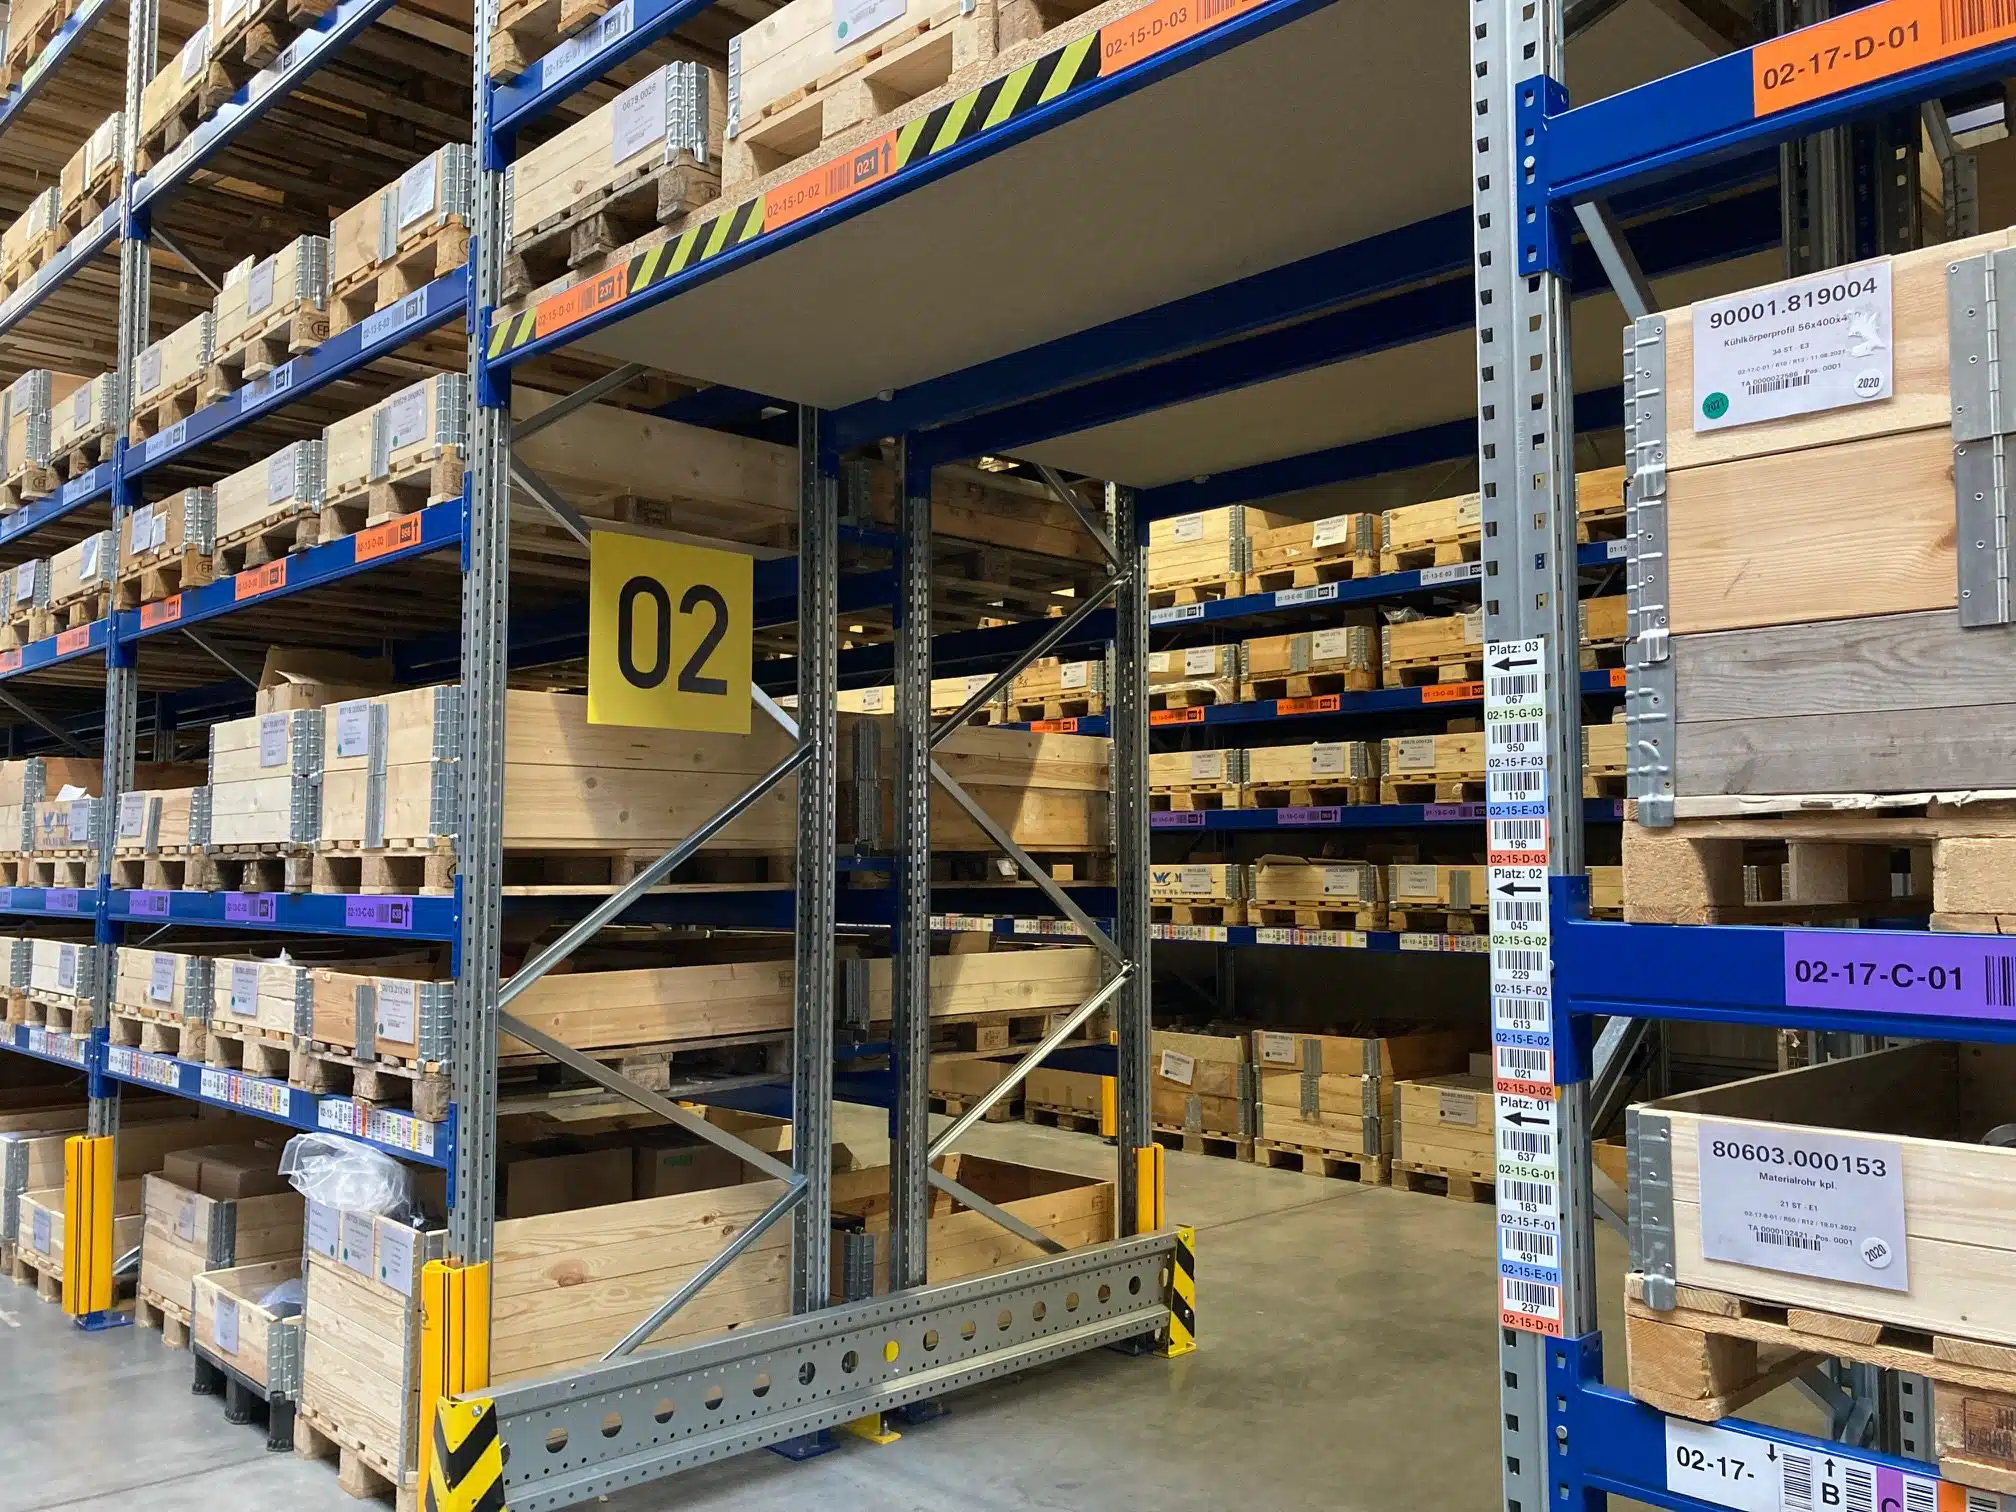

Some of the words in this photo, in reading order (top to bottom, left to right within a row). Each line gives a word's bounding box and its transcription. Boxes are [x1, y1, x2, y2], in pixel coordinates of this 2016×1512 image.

[1105, 8, 1188, 58] 02-15-D-03
[1763, 20, 1919, 90] 02-17-D-01
[767, 183, 820, 218] 02-15-D-02
[856, 156, 875, 176] 021
[537, 301, 574, 327] 02-15-D-01
[599, 281, 613, 298] 237
[1710, 277, 1878, 329] 90001.819004
[1723, 325, 1795, 348] Kühlkörperprofil
[1772, 347, 1782, 356] 34
[1784, 345, 1793, 354] ST
[1800, 342, 1809, 351] E3
[1741, 380, 1751, 388] TA
[1822, 362, 1841, 372] 0001
[1857, 377, 1880, 389] 2020
[1705, 398, 1725, 412] 2021
[618, 575, 729, 696] 02
[1489, 643, 1521, 656] Platz:
[1525, 641, 1539, 652] 03
[1505, 694, 1523, 704] 067
[1487, 707, 1544, 720] 02-15-G-03
[1506, 743, 1525, 752] 950
[1488, 756, 1544, 768] 02-15-F-03
[1508, 791, 1526, 801] 110
[1489, 805, 1545, 816] 02-15-E-03
[1509, 839, 1527, 849] 196
[1490, 854, 1547, 865] 02-15-D-03
[1494, 868, 1525, 879] Platz:
[1528, 868, 1542, 879] 02
[1510, 921, 1528, 931] 045
[1492, 935, 1547, 946] 02-15-G-02
[1511, 970, 1529, 980] 229
[1795, 959, 1962, 990] 02-17-C-01
[1494, 983, 1548, 996] 02-15-F-02
[1513, 1020, 1531, 1030] 613
[1495, 1033, 1550, 1046] 02-15-E-02
[1514, 1069, 1531, 1080] 021
[1496, 1082, 1552, 1096] 02-15-D-02
[1500, 1096, 1533, 1110] Platz:
[1536, 1099, 1550, 1111] 01
[1517, 1152, 1535, 1163] 637
[1712, 1140, 1887, 1177] 80603.000153
[1498, 1164, 1555, 1180] 02-15-G-01
[1759, 1172, 1816, 1187] Materialrohr
[1819, 1180, 1838, 1190] kpl.
[1519, 1202, 1537, 1213] 183
[1780, 1200, 1789, 1208] 21
[1791, 1202, 1801, 1210] ST
[1809, 1204, 1818, 1212] E1
[1500, 1213, 1556, 1231] 02-15-F-01
[1761, 1226, 1808, 1239] 0000102421
[1815, 1233, 1829, 1243] Pos.
[1833, 1237, 1853, 1246] 0001
[1520, 1252, 1538, 1263] 491
[1864, 1243, 1887, 1262] 2020
[1501, 1263, 1558, 1282] 02-15-E-01
[1521, 1302, 1540, 1314] 237
[1502, 1314, 1560, 1334] 02-15-D-01
[1676, 1445, 1755, 1480] 02-17-
[1822, 1482, 1841, 1506] B
